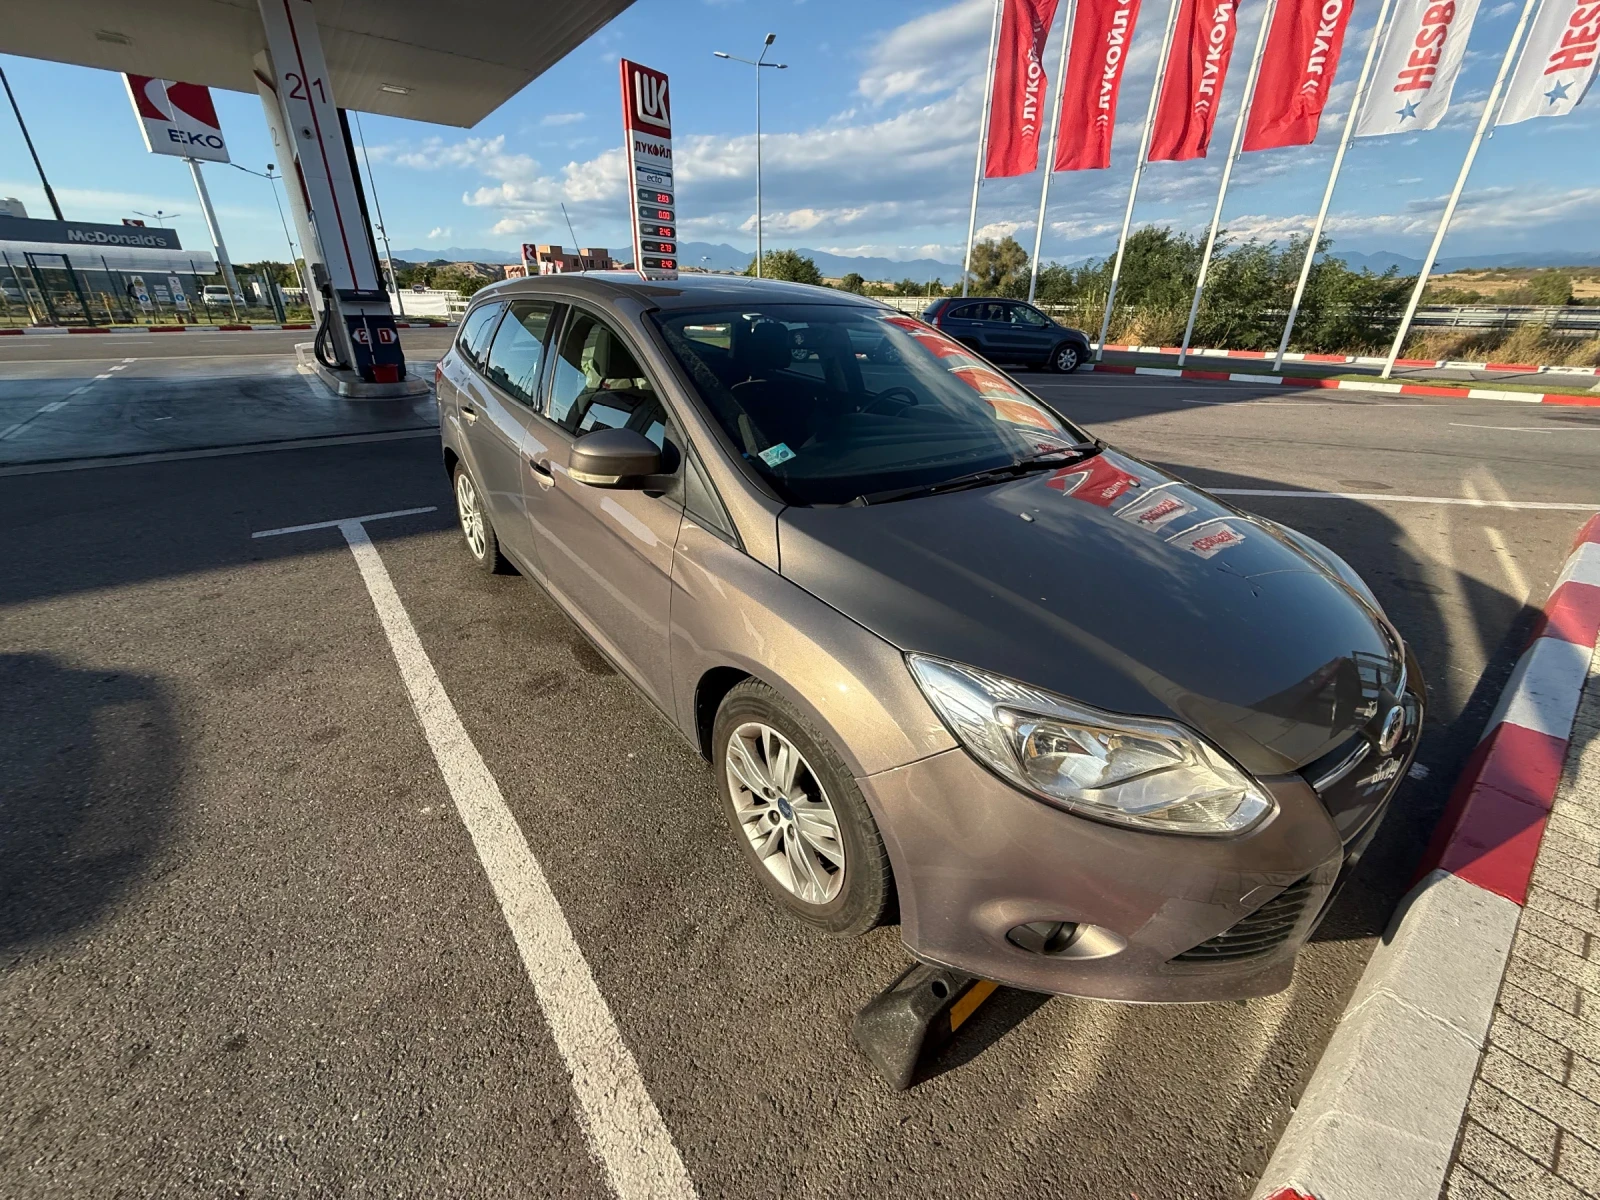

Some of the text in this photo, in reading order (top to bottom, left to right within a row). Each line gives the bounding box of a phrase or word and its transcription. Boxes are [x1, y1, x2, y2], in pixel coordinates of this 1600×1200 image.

[1098, 9, 1130, 110] ЛУКОЙЛ
[1199, 0, 1233, 96] ЛУКОЙ
[1394, 0, 1456, 92] HESB
[1544, 0, 1600, 75] HES
[285, 72, 327, 104] 2 1
[167, 128, 224, 149] EKO
[646, 174, 663, 184] ecto
[67, 229, 167, 247] McDonald's
